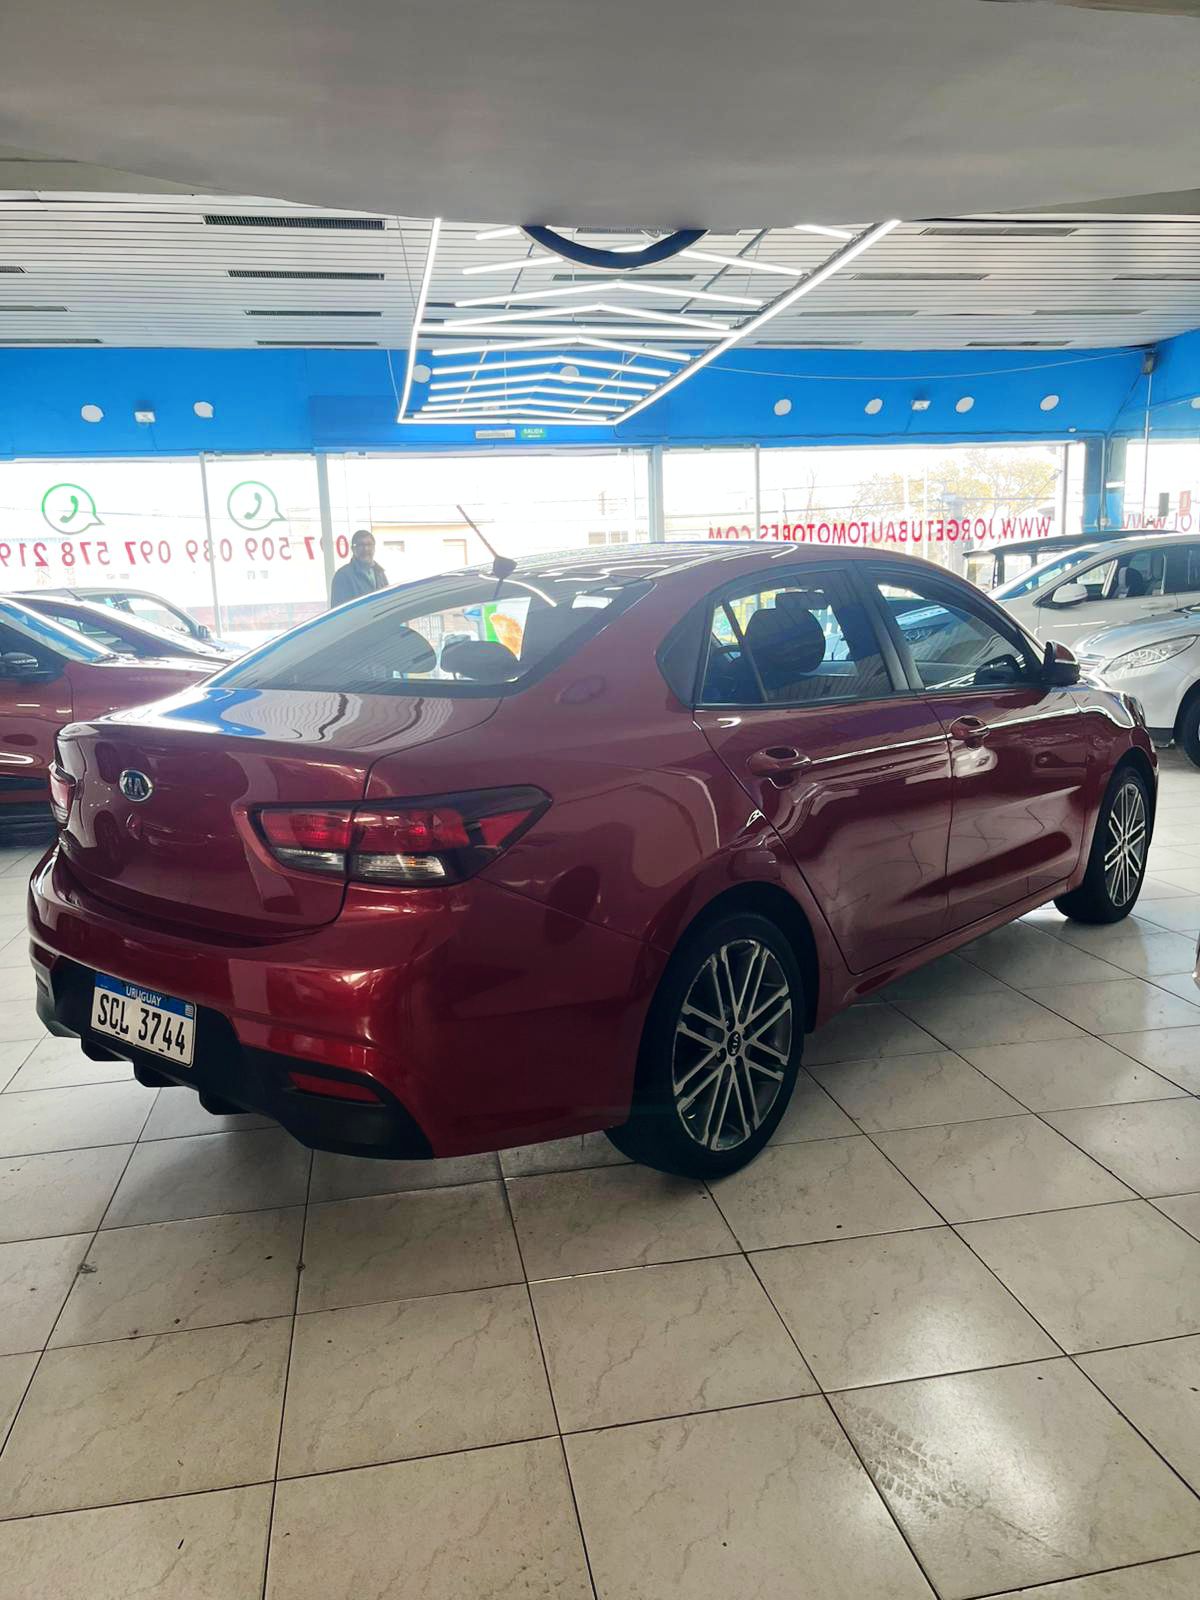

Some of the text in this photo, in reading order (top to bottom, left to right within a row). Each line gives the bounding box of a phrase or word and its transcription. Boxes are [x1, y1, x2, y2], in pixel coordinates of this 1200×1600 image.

[125, 984, 162, 1008] URUGUAY
[97, 993, 186, 1056] SCL 3744
